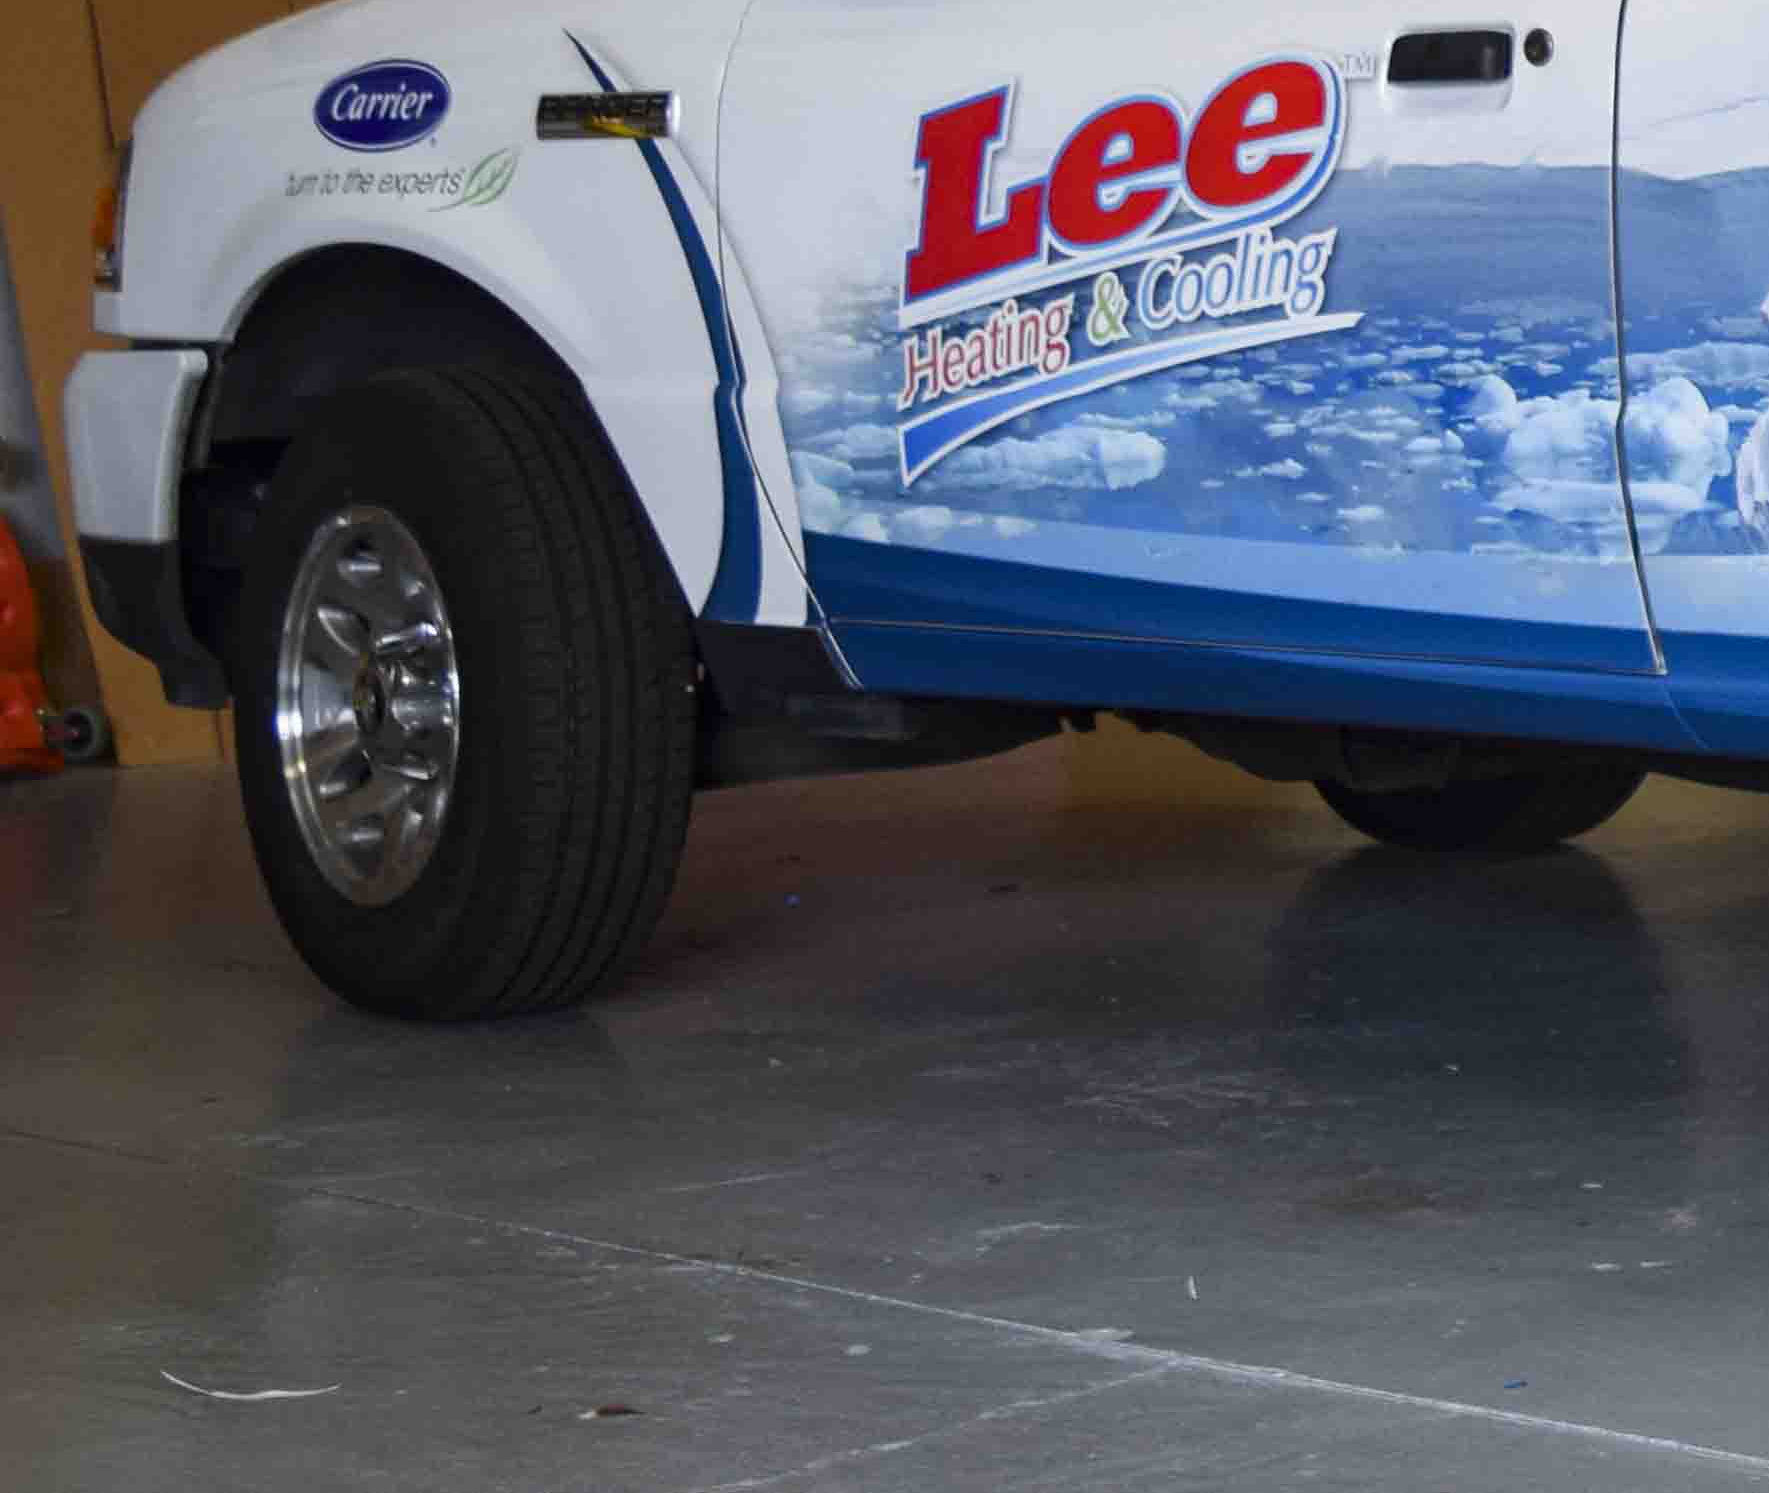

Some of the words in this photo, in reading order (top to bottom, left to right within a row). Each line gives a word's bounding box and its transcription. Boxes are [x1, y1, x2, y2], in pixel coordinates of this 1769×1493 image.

[331, 83, 434, 122] Carrier
[342, 167, 375, 195] the
[377, 168, 464, 200] experts
[904, 58, 1332, 302] Lee
[902, 297, 1072, 404] Heating
[1090, 271, 1129, 344] &
[1140, 229, 1335, 327] Cooling
